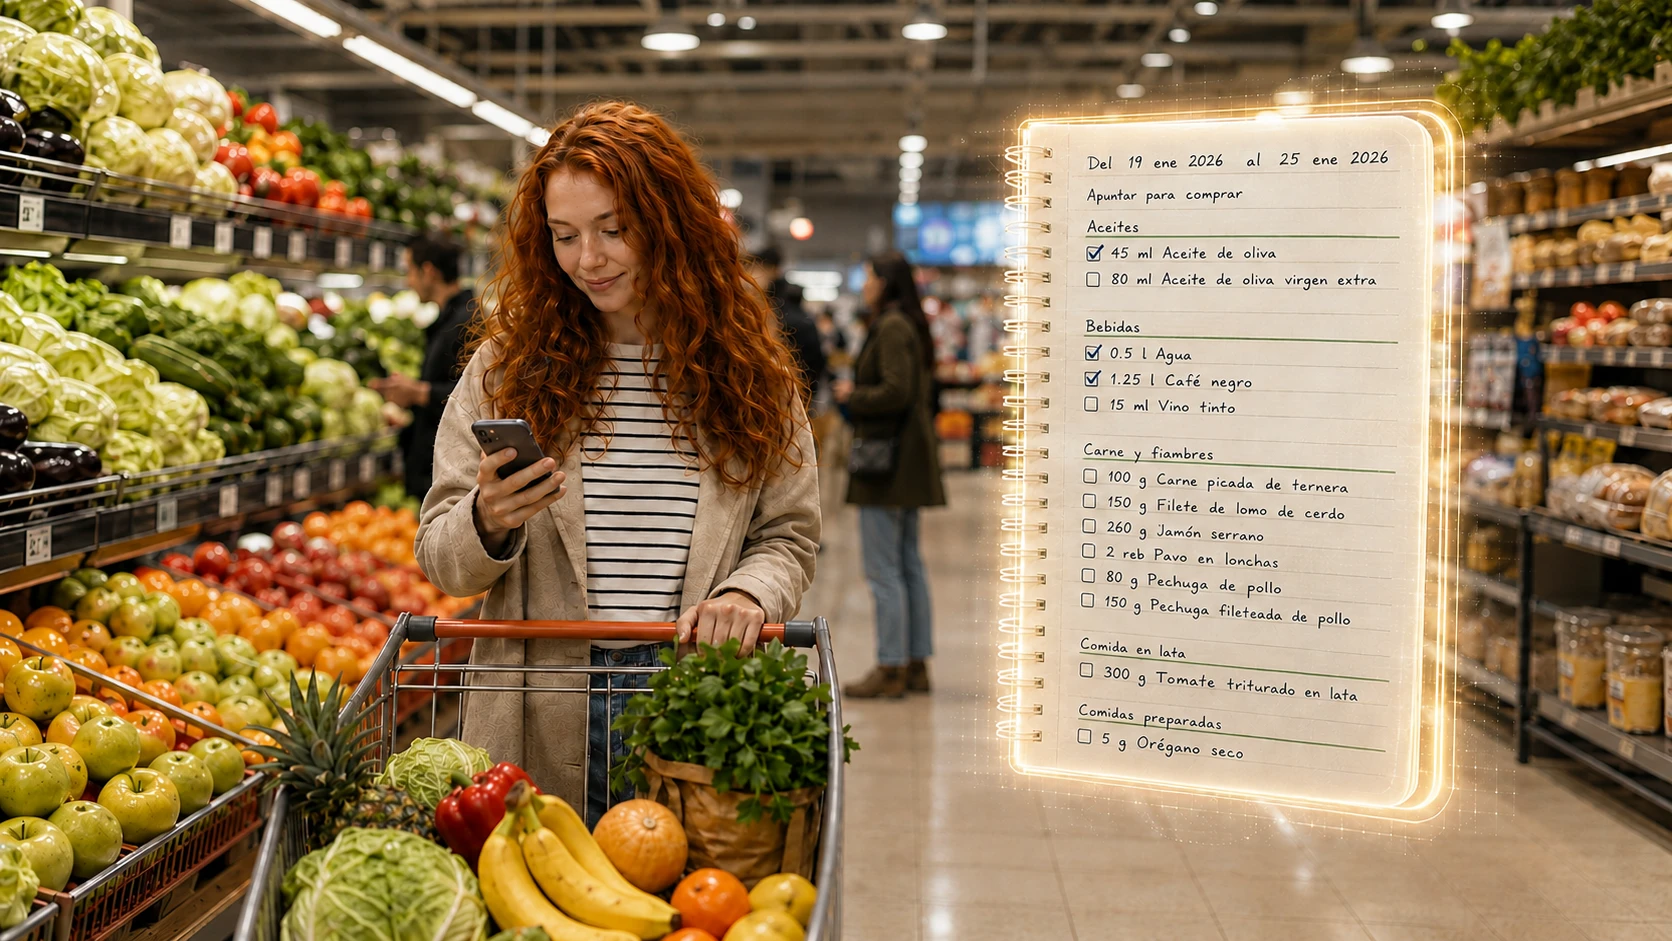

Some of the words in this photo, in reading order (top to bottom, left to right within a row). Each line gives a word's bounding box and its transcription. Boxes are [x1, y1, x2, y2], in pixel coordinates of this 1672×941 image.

[1087, 155, 1112, 171] Del
[1128, 155, 1143, 169] 19
[1153, 159, 1178, 169] ene
[1188, 153, 1224, 168] 2026
[1246, 151, 1261, 167] al
[1279, 152, 1301, 166] 25
[1312, 156, 1338, 166] ene
[1350, 149, 1389, 165] 2026
[1086, 188, 1138, 206] Apuntar
[1145, 192, 1176, 205] para
[1185, 190, 1244, 204] comprar
[1086, 219, 1139, 233] Aceites
[1110, 246, 1129, 259] 45
[1137, 246, 1153, 259] ml
[1162, 245, 1207, 260] Aceite
[1217, 246, 1234, 260] de
[1243, 245, 1277, 259] oliva
[1111, 272, 1129, 285] 80
[1136, 272, 1152, 285] ml
[1161, 271, 1207, 286] Aceite
[1216, 272, 1233, 286] de
[1242, 272, 1275, 286] oliva
[1284, 274, 1328, 291] virgen
[1337, 273, 1377, 286] extra
[1086, 319, 1140, 334] Bebidas
[1110, 346, 1133, 360] 0.5
[1142, 346, 1147, 360] l
[1155, 346, 1192, 366] Agua
[1110, 372, 1142, 386] 1.25
[1150, 373, 1155, 387] l
[1165, 373, 1201, 388] Café
[1211, 379, 1253, 394] negro
[1110, 398, 1125, 411] 15
[1133, 398, 1149, 412] ml
[1157, 399, 1190, 413] Vino
[1199, 400, 1236, 414] tinto
[1083, 443, 1124, 458] Carne
[1133, 450, 1142, 463] y
[1151, 446, 1214, 461] fiambres
[1108, 470, 1131, 483] 100
[1138, 476, 1147, 490] g
[1156, 472, 1198, 487] Carne
[1207, 476, 1255, 493] picada
[1265, 477, 1282, 491] de
[1291, 478, 1349, 494] ternera
[1107, 495, 1132, 509] 150
[1138, 502, 1147, 516] g
[1157, 498, 1199, 513] Filete
[1208, 501, 1226, 514] de
[1236, 501, 1268, 516] lomo
[1277, 504, 1295, 518] de
[1304, 507, 1345, 520] cerdo
[1106, 520, 1132, 534] 260
[1138, 528, 1147, 541] g
[1156, 523, 1202, 539] Jamón
[1210, 530, 1264, 542] serrano
[1106, 545, 1115, 558] 2
[1123, 547, 1145, 560] reb
[1154, 547, 1188, 563] Pavo
[1197, 555, 1214, 565] en
[1225, 551, 1279, 569] lonchas
[1106, 570, 1123, 583] 80
[1130, 577, 1139, 590] g
[1147, 572, 1209, 595] Pechuga
[1219, 578, 1236, 592] de
[1246, 580, 1282, 599] pollo
[1104, 595, 1127, 609] 150
[1133, 602, 1142, 616] g
[1150, 598, 1210, 620] Pechuga
[1218, 603, 1283, 621] fileteada
[1291, 609, 1308, 623] de
[1317, 611, 1351, 630] pollo
[1080, 637, 1128, 653] Comida
[1136, 647, 1152, 656] en
[1159, 644, 1187, 659] lata
[1103, 666, 1130, 680] 300
[1137, 674, 1146, 688] g
[1155, 671, 1216, 689] Tomate
[1226, 677, 1296, 696] triturado
[1304, 689, 1321, 698] en
[1330, 686, 1358, 702] lata
[1079, 704, 1134, 721] Comidas
[1144, 714, 1222, 730] preparadas
[1101, 732, 1110, 745] 5
[1118, 739, 1127, 753] g
[1136, 735, 1201, 757] Orégano
[1211, 747, 1244, 759] seco
